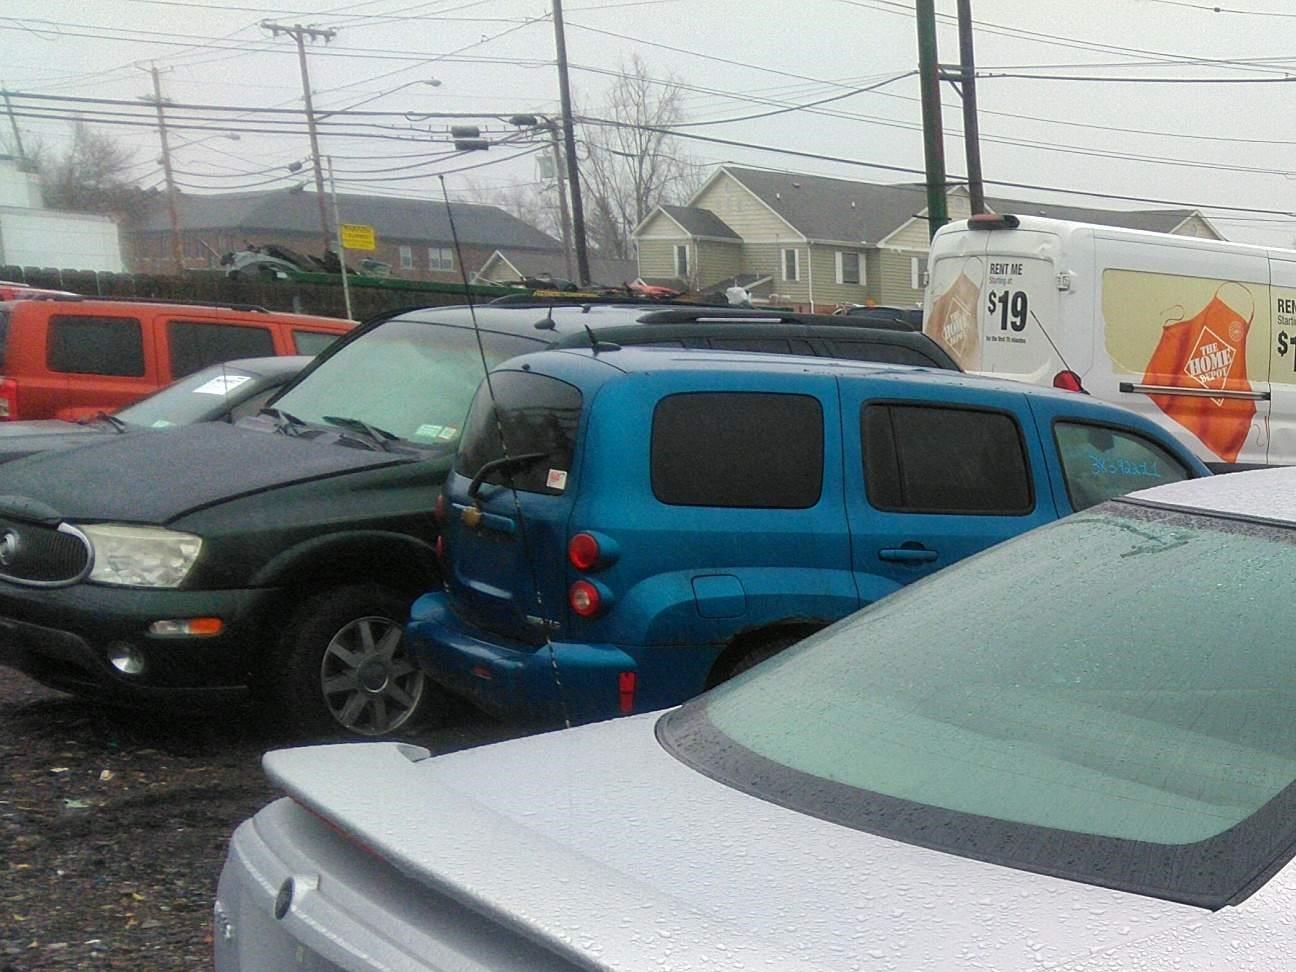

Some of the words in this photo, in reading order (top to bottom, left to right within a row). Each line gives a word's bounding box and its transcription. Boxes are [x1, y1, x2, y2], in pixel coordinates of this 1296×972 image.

[990, 263, 1009, 275] RENT
[1010, 264, 1023, 276] ME
[987, 290, 1028, 332] $19
[1200, 342, 1218, 355] THE
[1189, 347, 1232, 376] HOME
[1199, 366, 1228, 383] DEPOT
